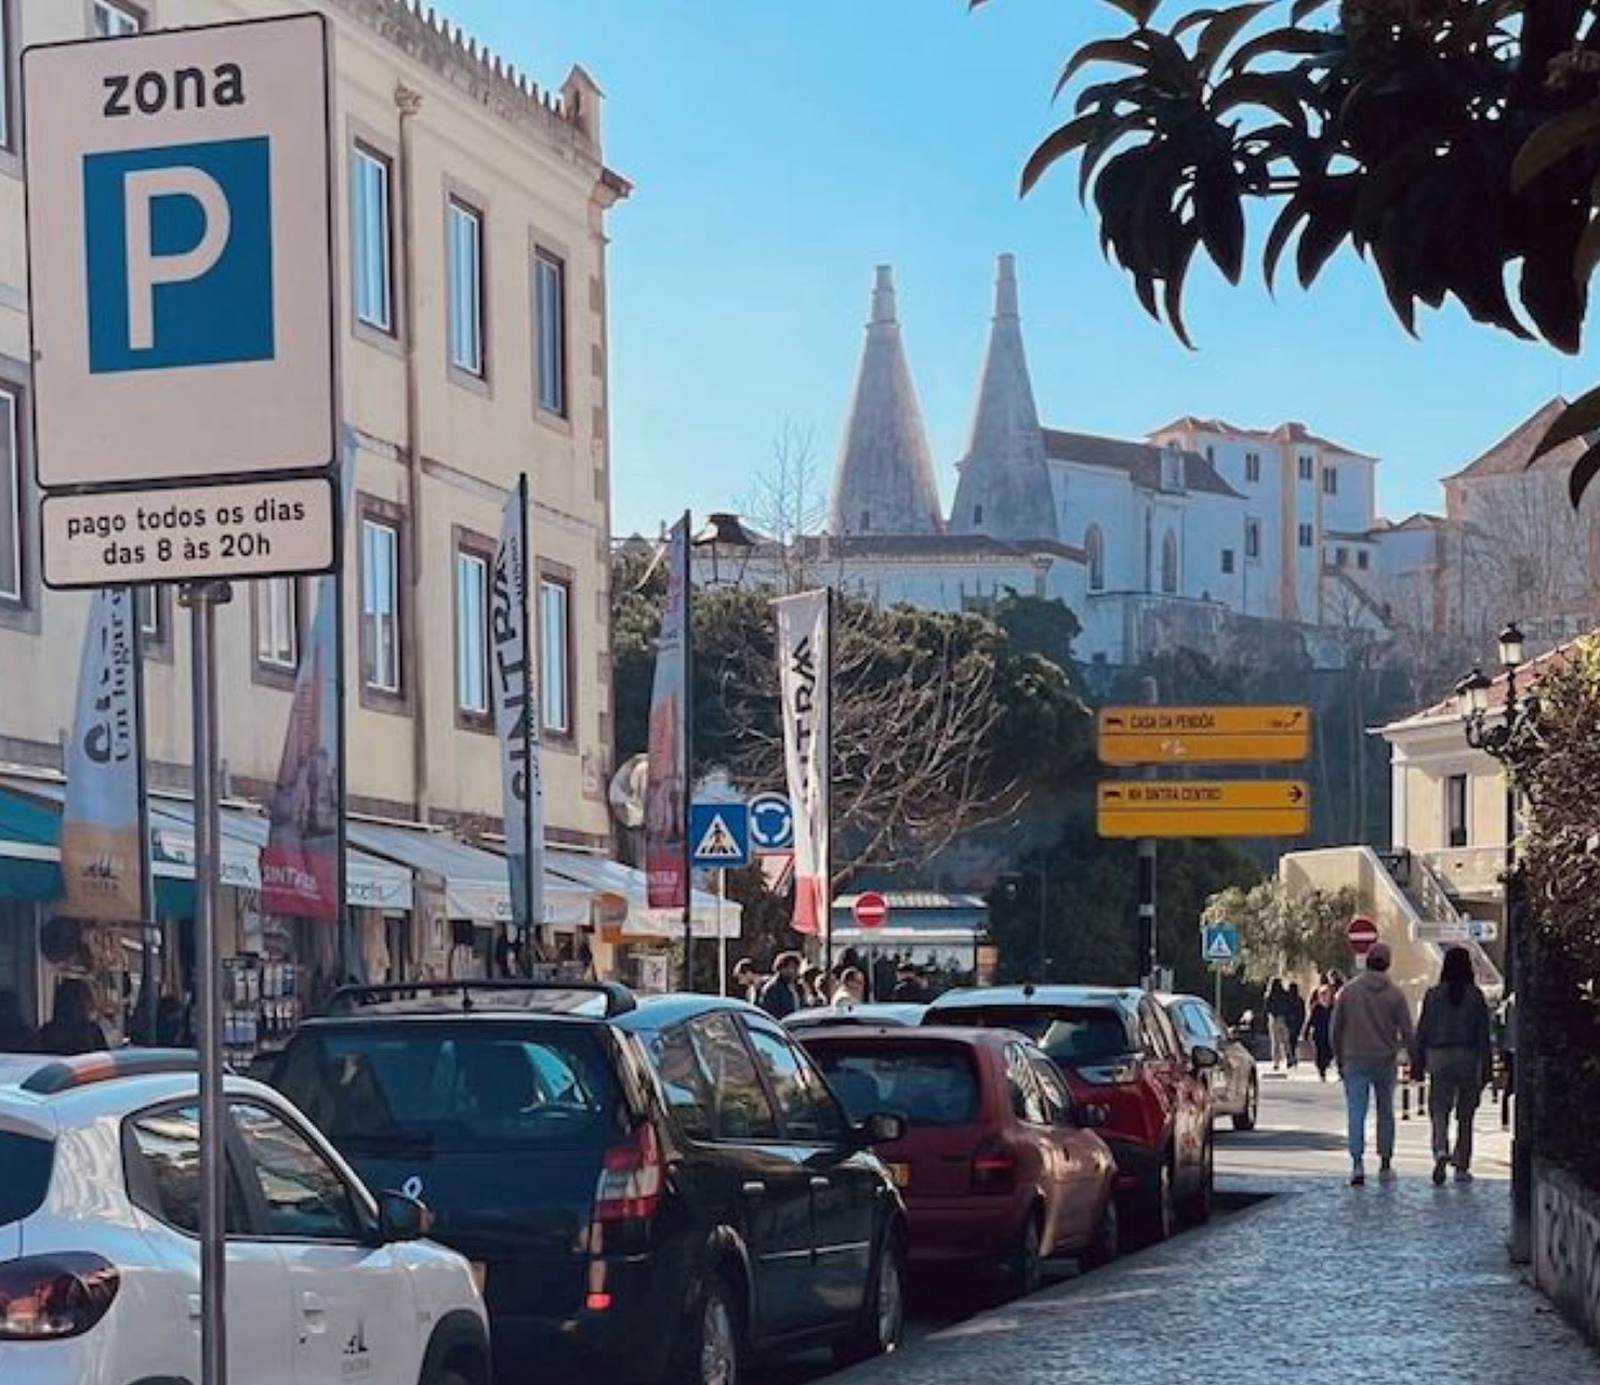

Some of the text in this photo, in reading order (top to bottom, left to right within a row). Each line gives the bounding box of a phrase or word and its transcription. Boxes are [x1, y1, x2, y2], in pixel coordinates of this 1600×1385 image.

[102, 62, 247, 118] zona
[123, 165, 231, 350] P
[67, 499, 306, 540] pago todos os dias
[103, 532, 272, 565] das 8 às 20h
